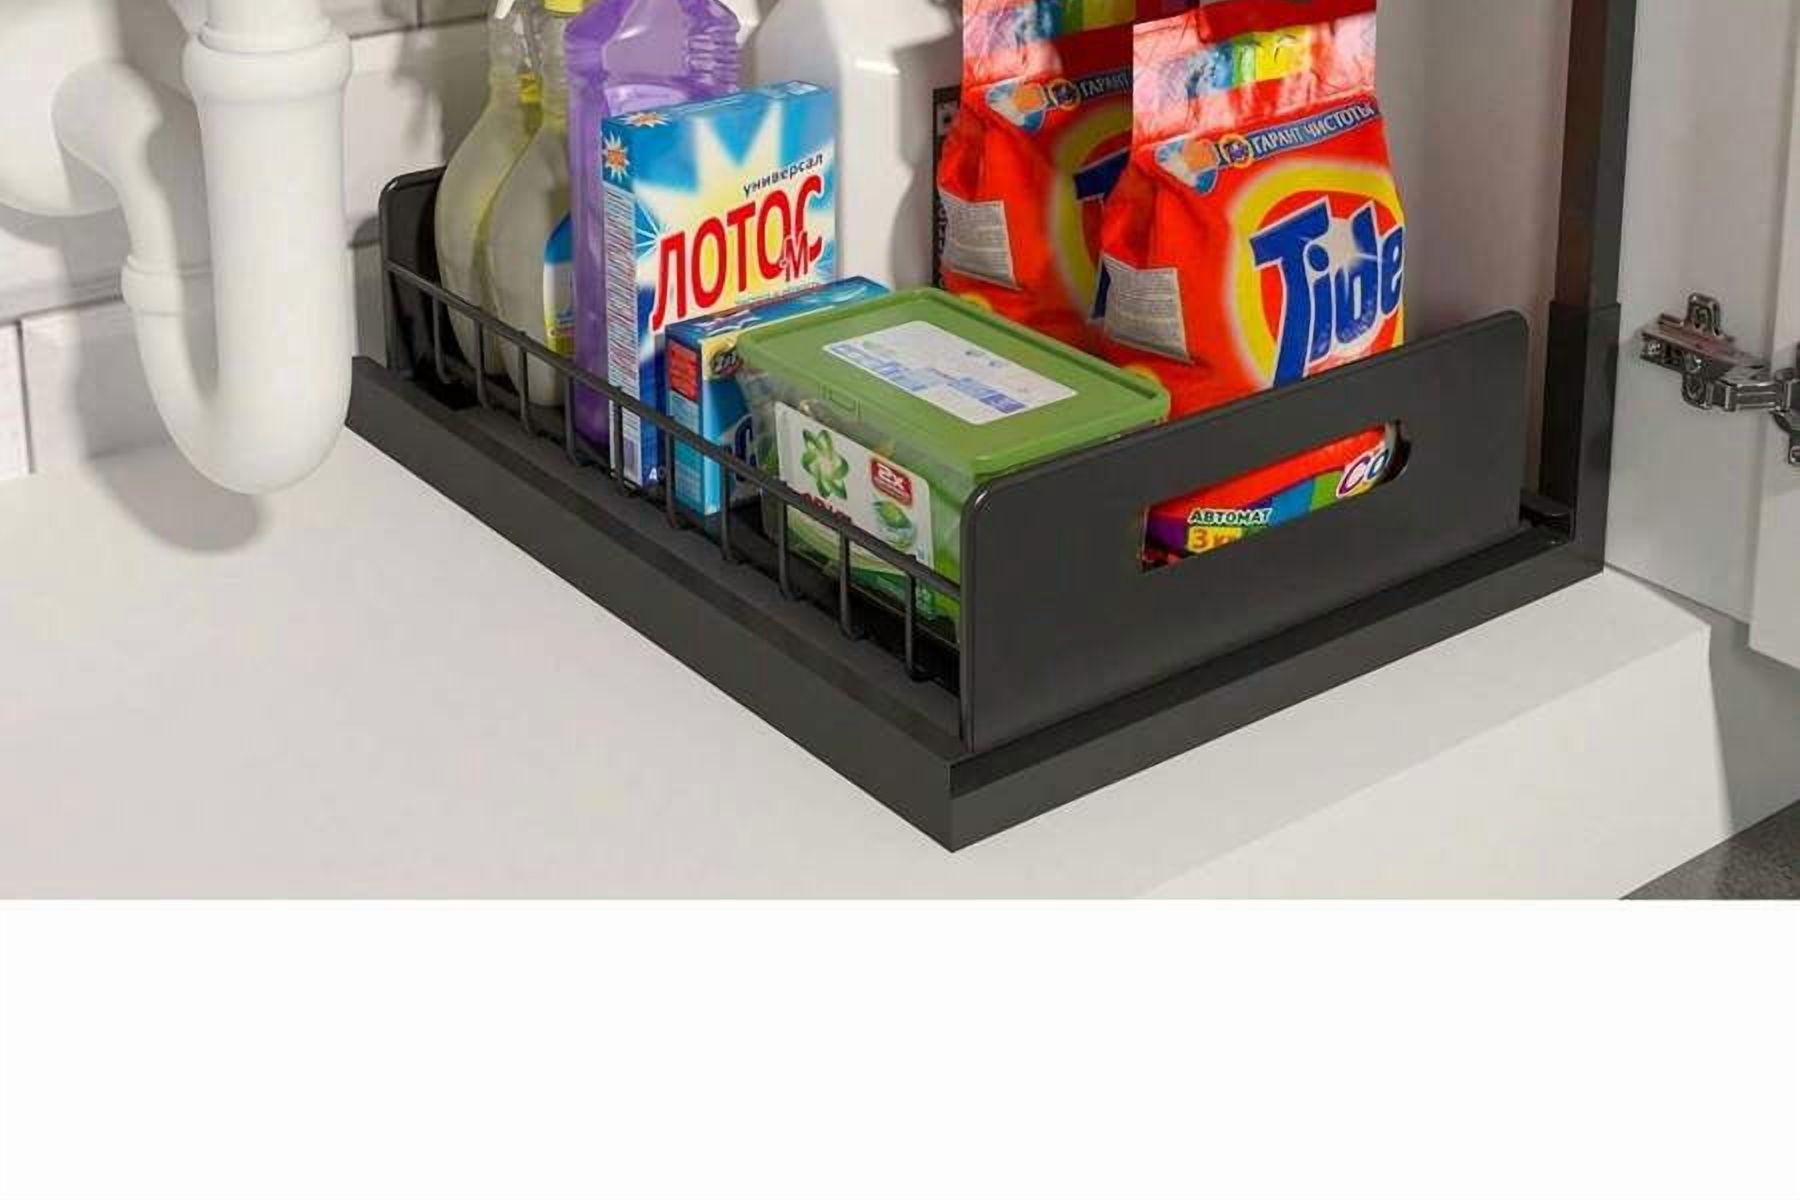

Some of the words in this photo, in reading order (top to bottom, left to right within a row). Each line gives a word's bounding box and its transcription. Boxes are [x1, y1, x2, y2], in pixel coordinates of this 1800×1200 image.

[1251, 126, 1303, 155] ГАРАНТ
[1304, 102, 1375, 138] ЧИСТОТЫ
[743, 153, 823, 199] универсал
[1249, 196, 1404, 388] Tide
[1191, 527, 1209, 550] 3
